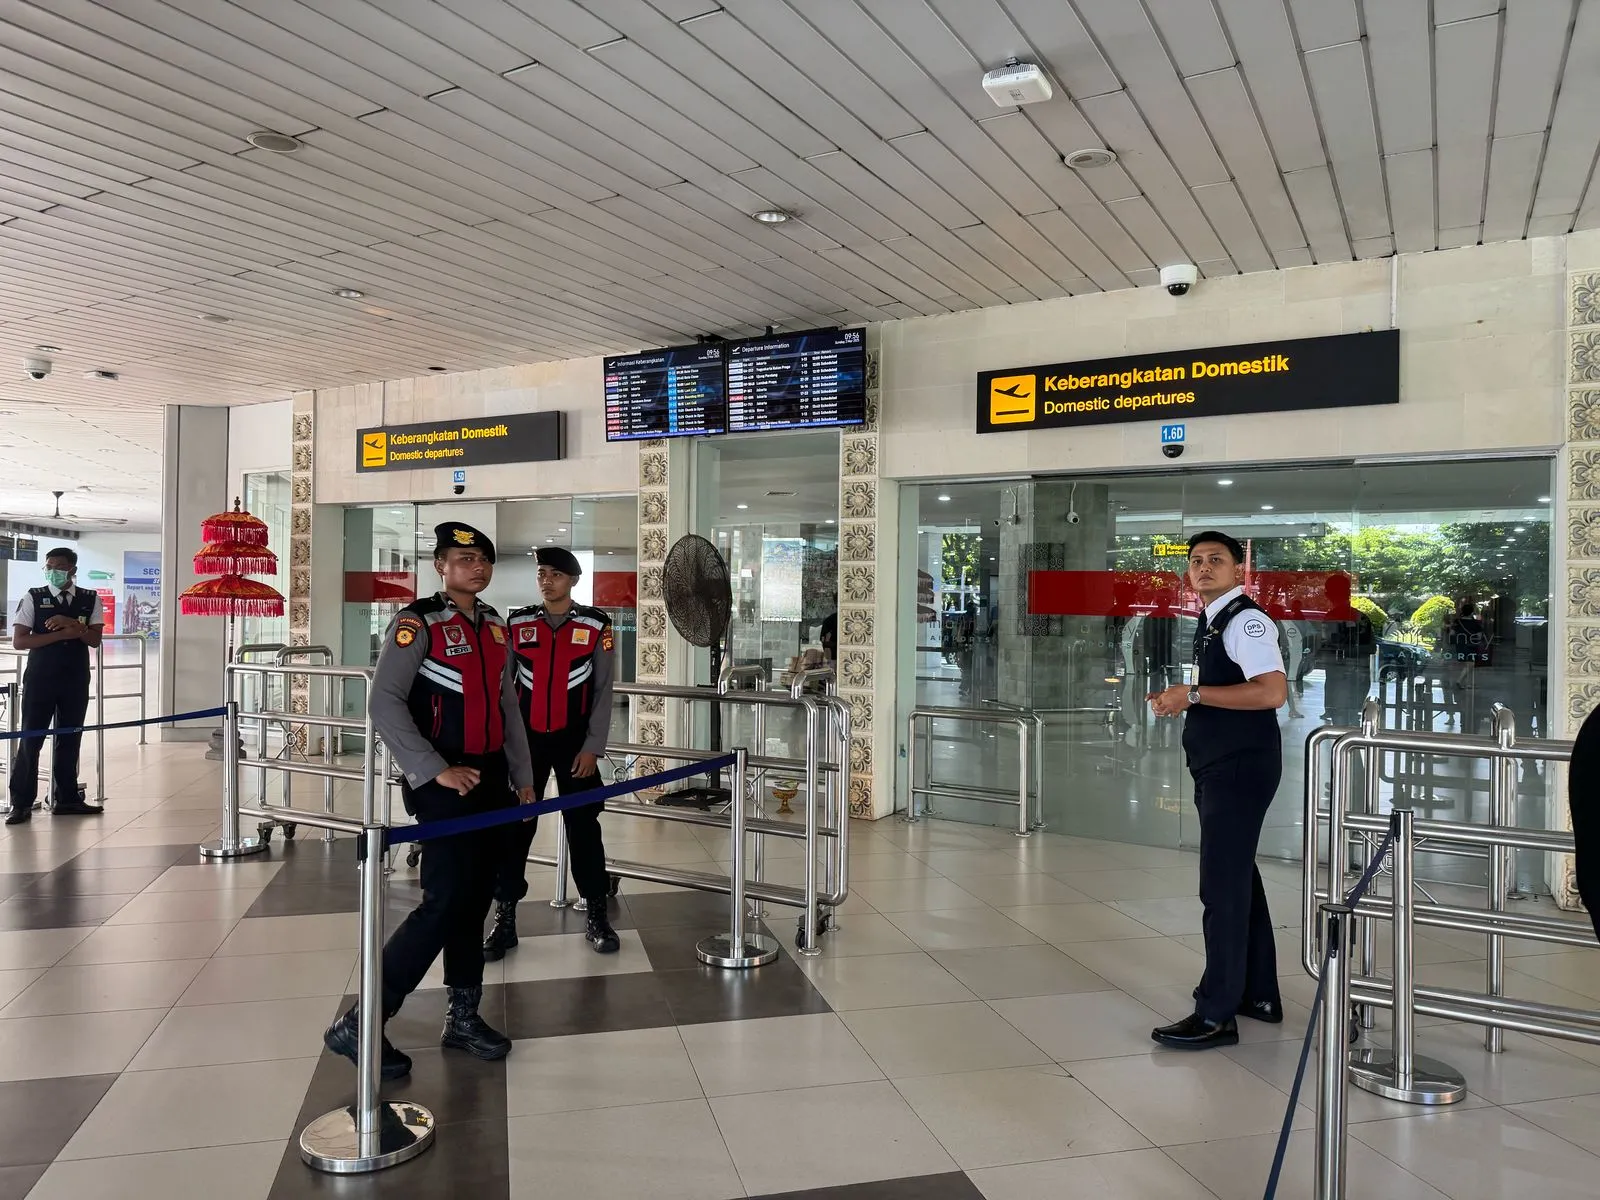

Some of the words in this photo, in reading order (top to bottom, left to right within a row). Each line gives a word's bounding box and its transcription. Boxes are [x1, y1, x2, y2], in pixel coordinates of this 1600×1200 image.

[1044, 367, 1185, 392] Keberangkatan
[1191, 354, 1290, 379] Domestik
[1044, 397, 1110, 415] Domestic
[1114, 390, 1196, 411] departures
[390, 430, 459, 446] Keberangkatan
[461, 424, 508, 439] Domestik
[1163, 427, 1183, 440] 1.6D
[390, 450, 423, 461] Domestic
[424, 448, 464, 461] departures
[1246, 623, 1262, 631] DPS
